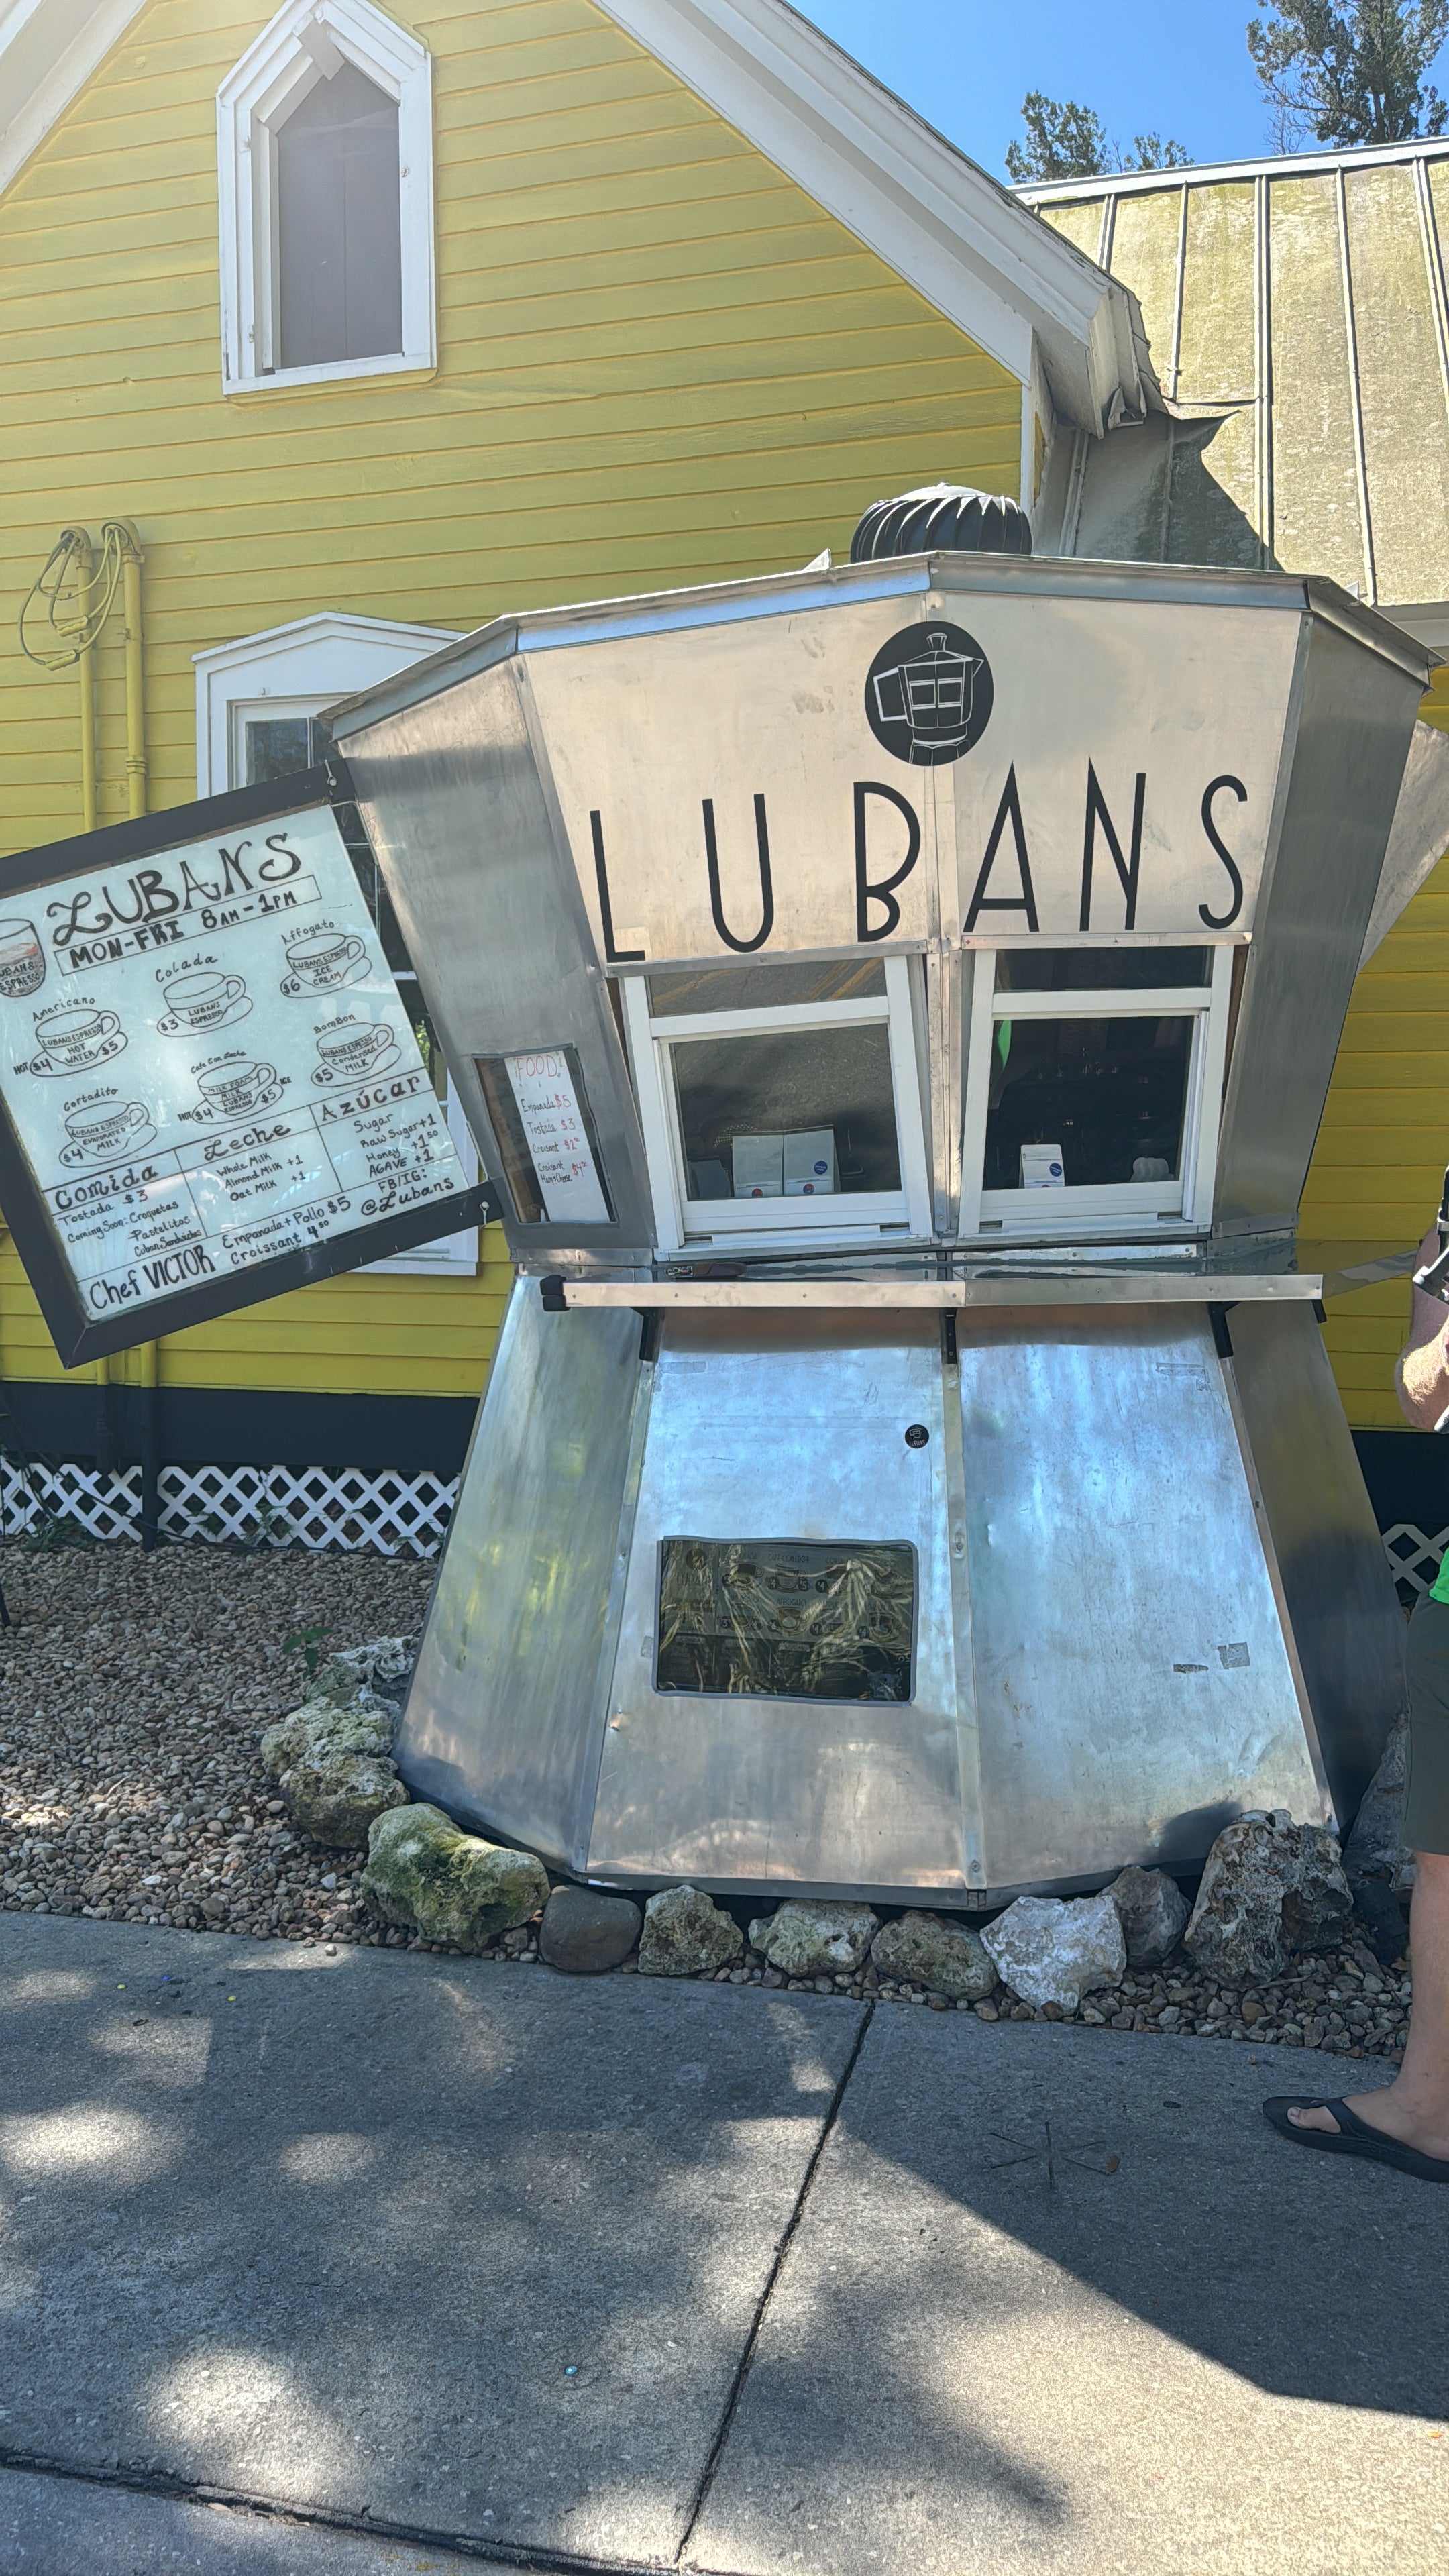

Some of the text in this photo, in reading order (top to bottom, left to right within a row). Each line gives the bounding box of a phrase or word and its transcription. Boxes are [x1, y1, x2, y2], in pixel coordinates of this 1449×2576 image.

[590, 755, 1248, 962] LUBANS
[46, 833, 301, 946] LUBANS
[281, 920, 335, 945] Affogato
[69, 920, 184, 969] MON-FRI
[292, 947, 347, 969] LUBANS ESPRESSO
[0, 961, 34, 977] UBANS
[156, 953, 218, 982] Colada
[313, 965, 332, 977] ICE
[283, 979, 300, 994] $6
[313, 972, 341, 985] CREAM
[33, 997, 95, 1022] Americano
[188, 1002, 220, 1016] LUBANS
[190, 1010, 223, 1024] ESPRESSO
[160, 1018, 179, 1032] $3
[42, 1024, 101, 1046] LUBANS ESPRESSO
[67, 1042, 85, 1054] HOT
[102, 1040, 118, 1055] $5
[321, 1048, 347, 1056] LUBANS
[332, 1045, 378, 1065] Condensed
[64, 1050, 95, 1064] WATER
[191, 1062, 206, 1073] Cafe
[207, 1055, 223, 1064] Con
[345, 1059, 369, 1072] MILK
[13, 1058, 53, 1075] HOT $4
[514, 1054, 558, 1083] FOOD
[280, 1077, 292, 1085] ICE
[315, 1068, 333, 1083] $5
[208, 1076, 254, 1093] MILK FOAM
[64, 1087, 118, 1111] Cortadito
[223, 1092, 253, 1106] LUBANS
[261, 1089, 276, 1104] $5
[322, 1075, 420, 1121] Azúcar
[555, 1093, 572, 1110] $5
[178, 1108, 213, 1122] HOT $4
[354, 1114, 393, 1133] Sugar
[71, 1127, 99, 1136] LUBANS
[388, 1123, 419, 1139] Sugar
[527, 1118, 576, 1136] Tostada $3
[83, 1127, 125, 1145] EVAPORATED
[97, 1138, 121, 1151] MILK
[204, 1125, 291, 1161] Leche
[64, 1148, 83, 1163] $4
[365, 1148, 401, 1162] Honey
[216, 1163, 248, 1177] Whole
[369, 1158, 407, 1178] AGAVE
[55, 1165, 158, 1210] Comida
[225, 1170, 260, 1189] Almond
[378, 1169, 427, 1193] FB/IG:
[229, 1189, 253, 1201] Oat
[361, 1177, 454, 1216] @Lubans
[57, 1189, 148, 1226] Tostada $3
[293, 1207, 324, 1225] Pollo
[327, 1195, 351, 1215] $5
[68, 1226, 105, 1243] Coming
[129, 1201, 179, 1224] Croquetas
[128, 1216, 190, 1241] Pastelitos
[134, 1243, 160, 1257] Cuban
[231, 1232, 301, 1265] Croissant
[90, 1244, 216, 1309] Chef VICTOR
